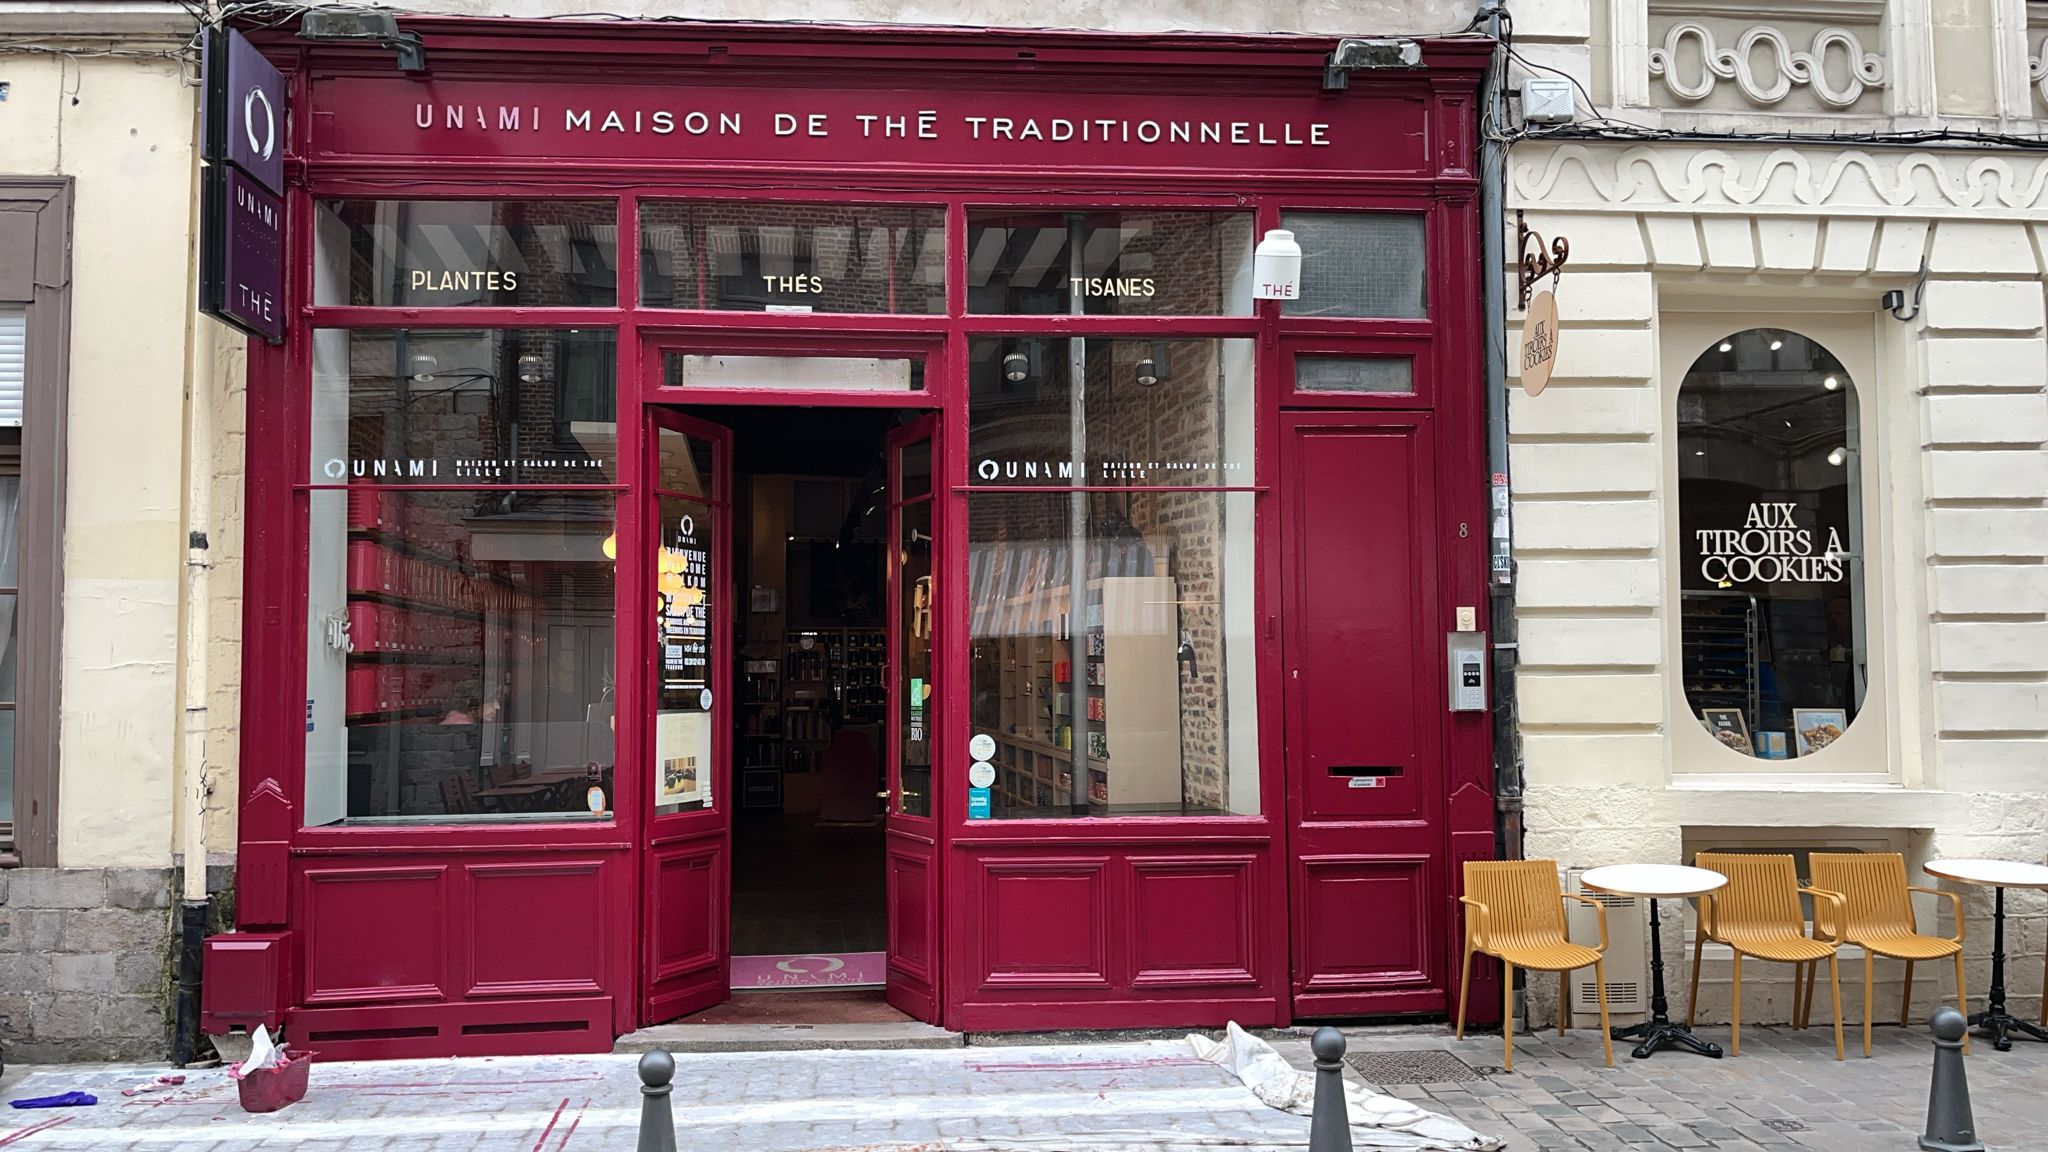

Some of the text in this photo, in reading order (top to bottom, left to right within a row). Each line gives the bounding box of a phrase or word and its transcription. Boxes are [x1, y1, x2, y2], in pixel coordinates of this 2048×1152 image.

[565, 109, 741, 135] MAISON
[774, 113, 829, 137] DE
[965, 116, 1331, 146] TRADITIONNELLE
[412, 270, 517, 291] PLANTES
[762, 273, 823, 294] THÉS
[1070, 277, 1156, 298] TISANES
[1262, 280, 1293, 297] THÉ
[1524, 345, 1553, 370] COOKIES
[456, 468, 502, 477] LILLE
[1103, 469, 1147, 479] LILLE
[1166, 462, 1199, 470] SALON
[1743, 502, 1798, 529] AUX
[1459, 523, 1468, 538] 8
[1696, 527, 1844, 556] TIROIRS À
[1701, 555, 1844, 583] COOKIES
[911, 728, 922, 741] BIO
